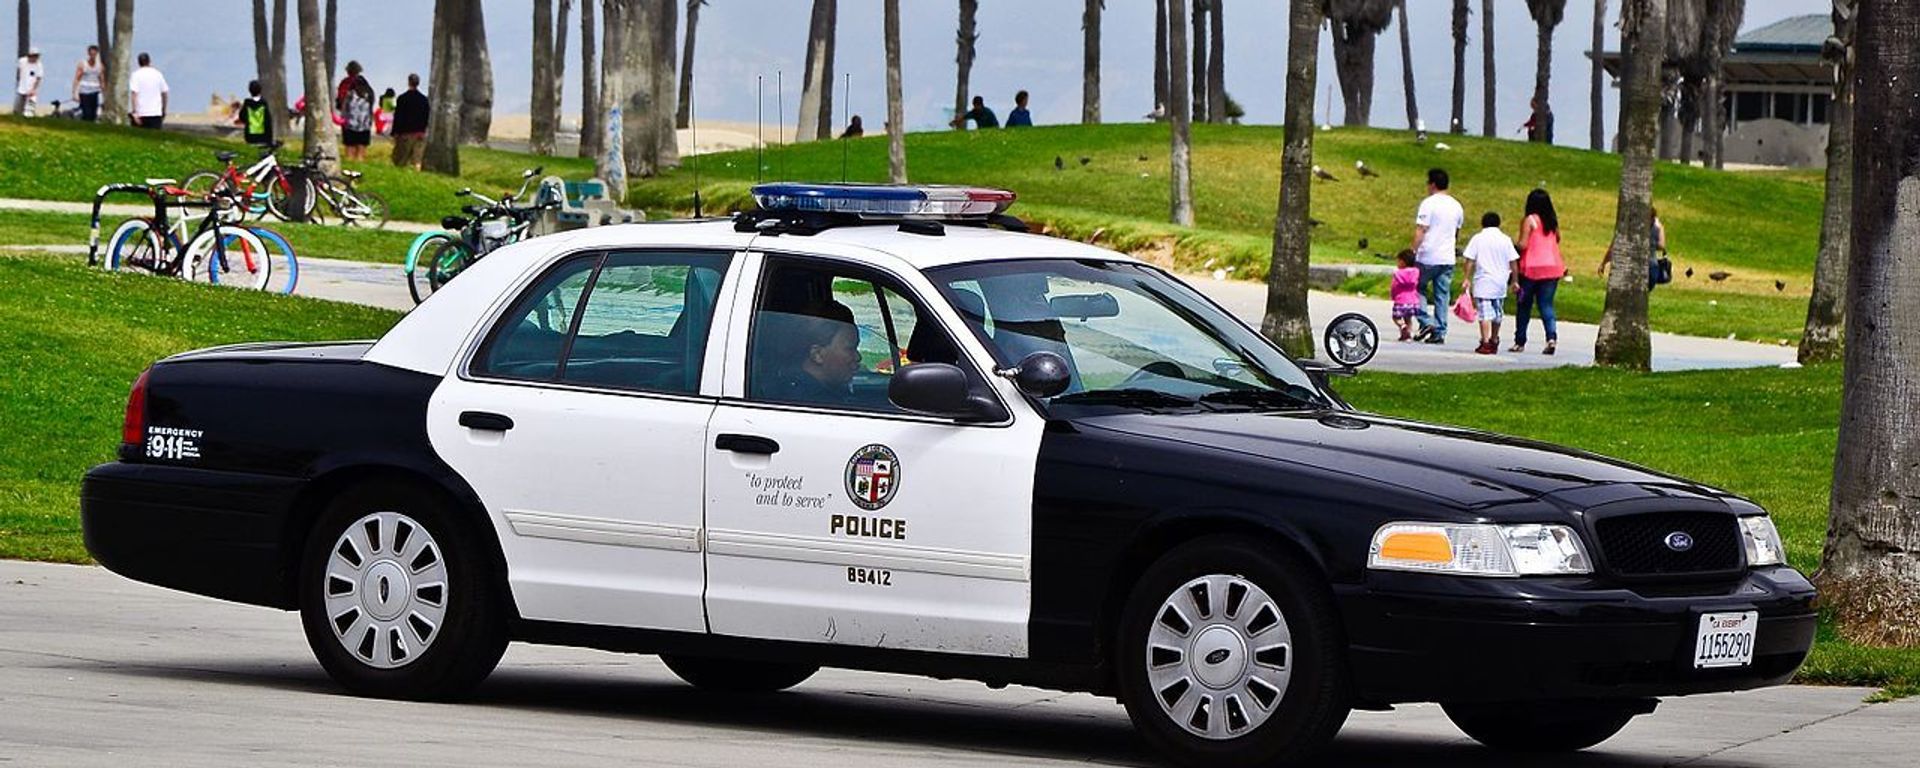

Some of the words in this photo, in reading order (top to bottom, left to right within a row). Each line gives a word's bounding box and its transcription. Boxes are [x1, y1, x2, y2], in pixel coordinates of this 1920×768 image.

[148, 426, 204, 438] EMERGENCY
[762, 475, 804, 492] protect
[755, 490, 780, 506] and
[781, 491, 794, 507] to
[830, 513, 907, 540] POLICE
[847, 566, 892, 586] 89412
[1699, 632, 1752, 660] 1155290
